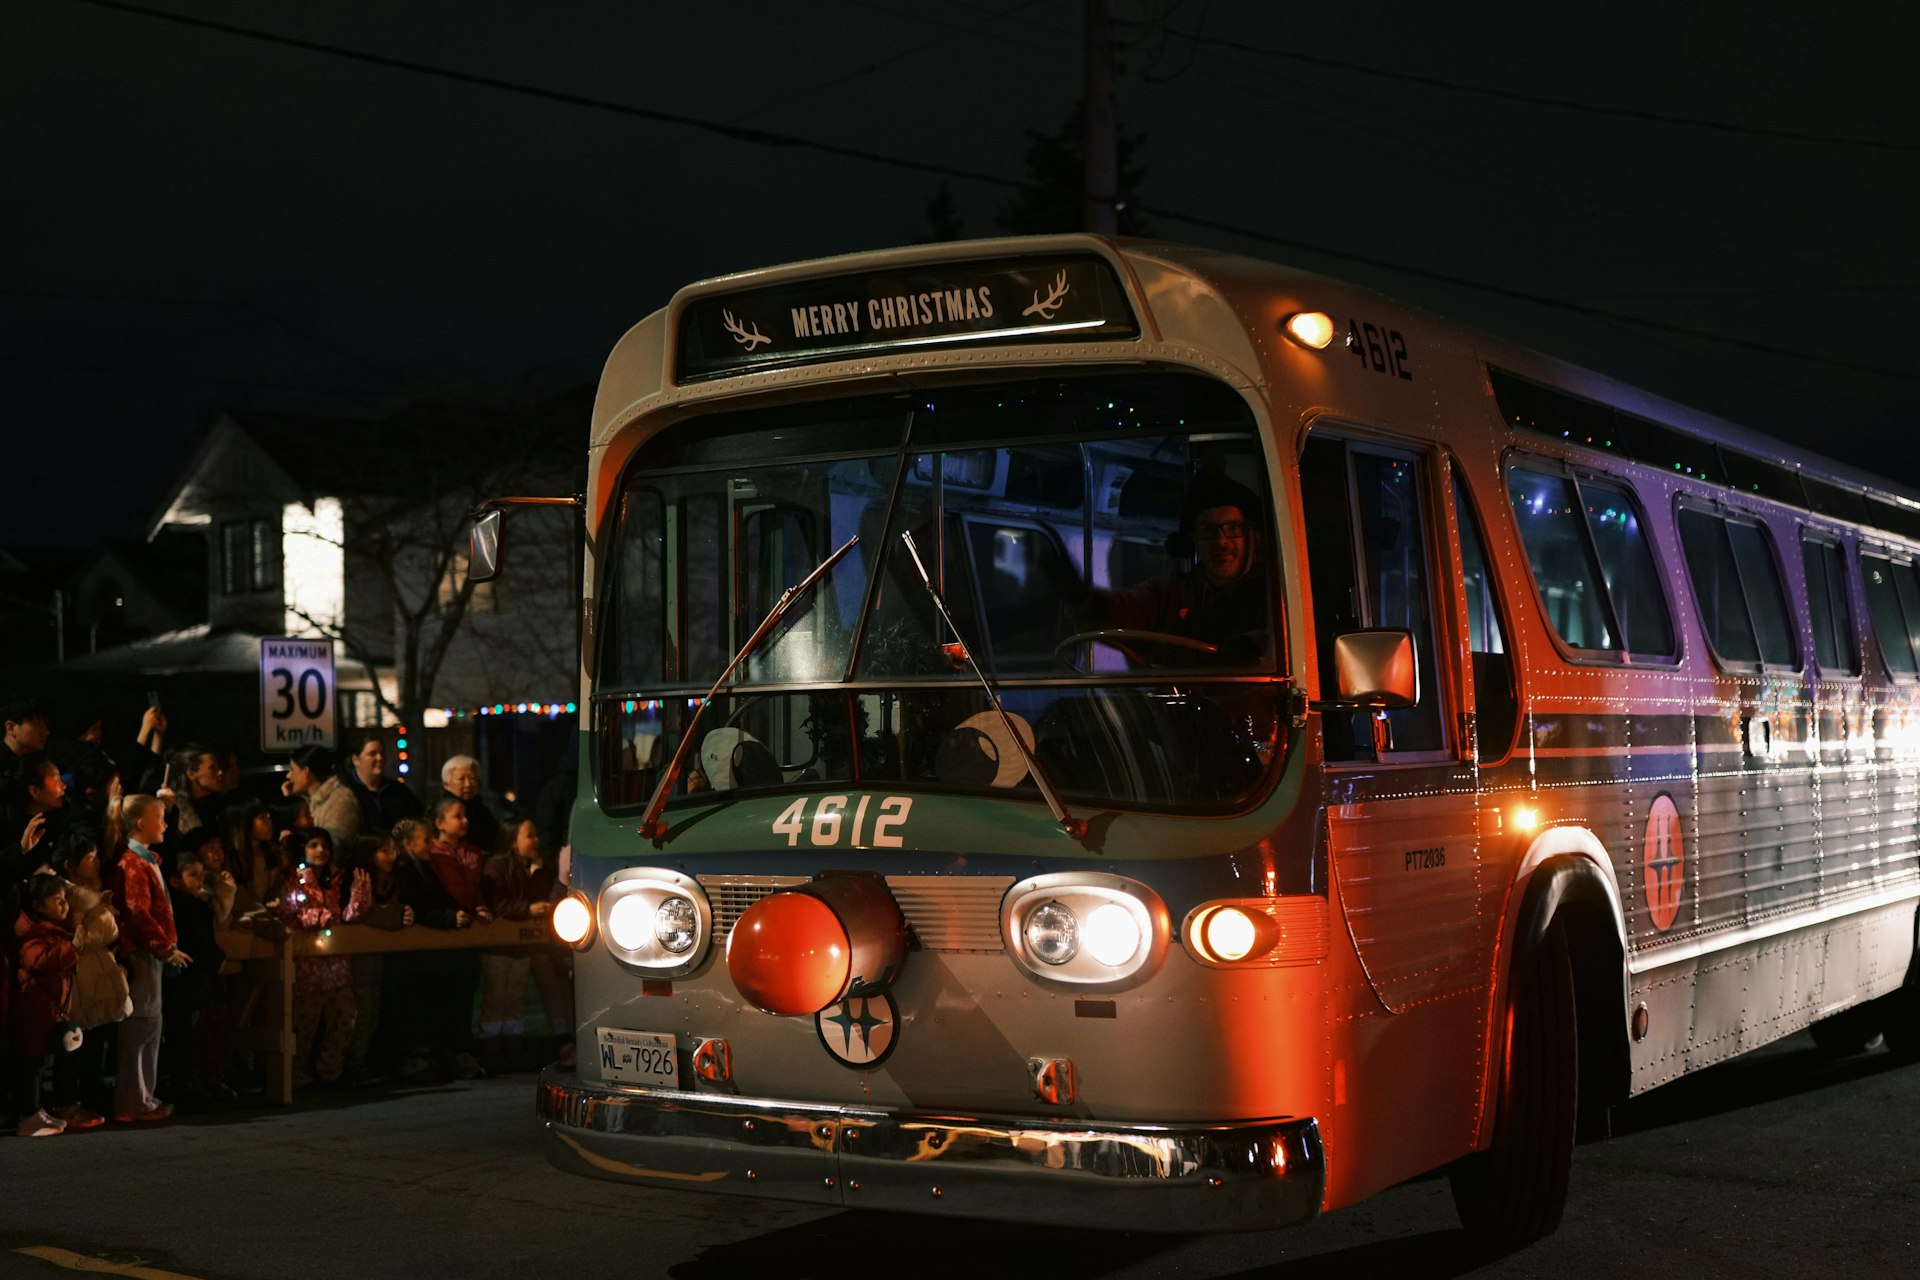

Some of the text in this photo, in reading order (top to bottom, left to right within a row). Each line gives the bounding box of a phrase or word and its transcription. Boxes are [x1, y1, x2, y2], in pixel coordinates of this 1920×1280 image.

[791, 286, 994, 338] MERRY CHRISTMAS
[1348, 319, 1413, 381] 4612
[268, 646, 327, 659] MAXIMUM
[271, 668, 326, 720] 30
[275, 724, 323, 741] km/h
[772, 795, 913, 848] 4612
[1405, 847, 1446, 871] PT72036
[600, 1044, 673, 1075] WL 7926
